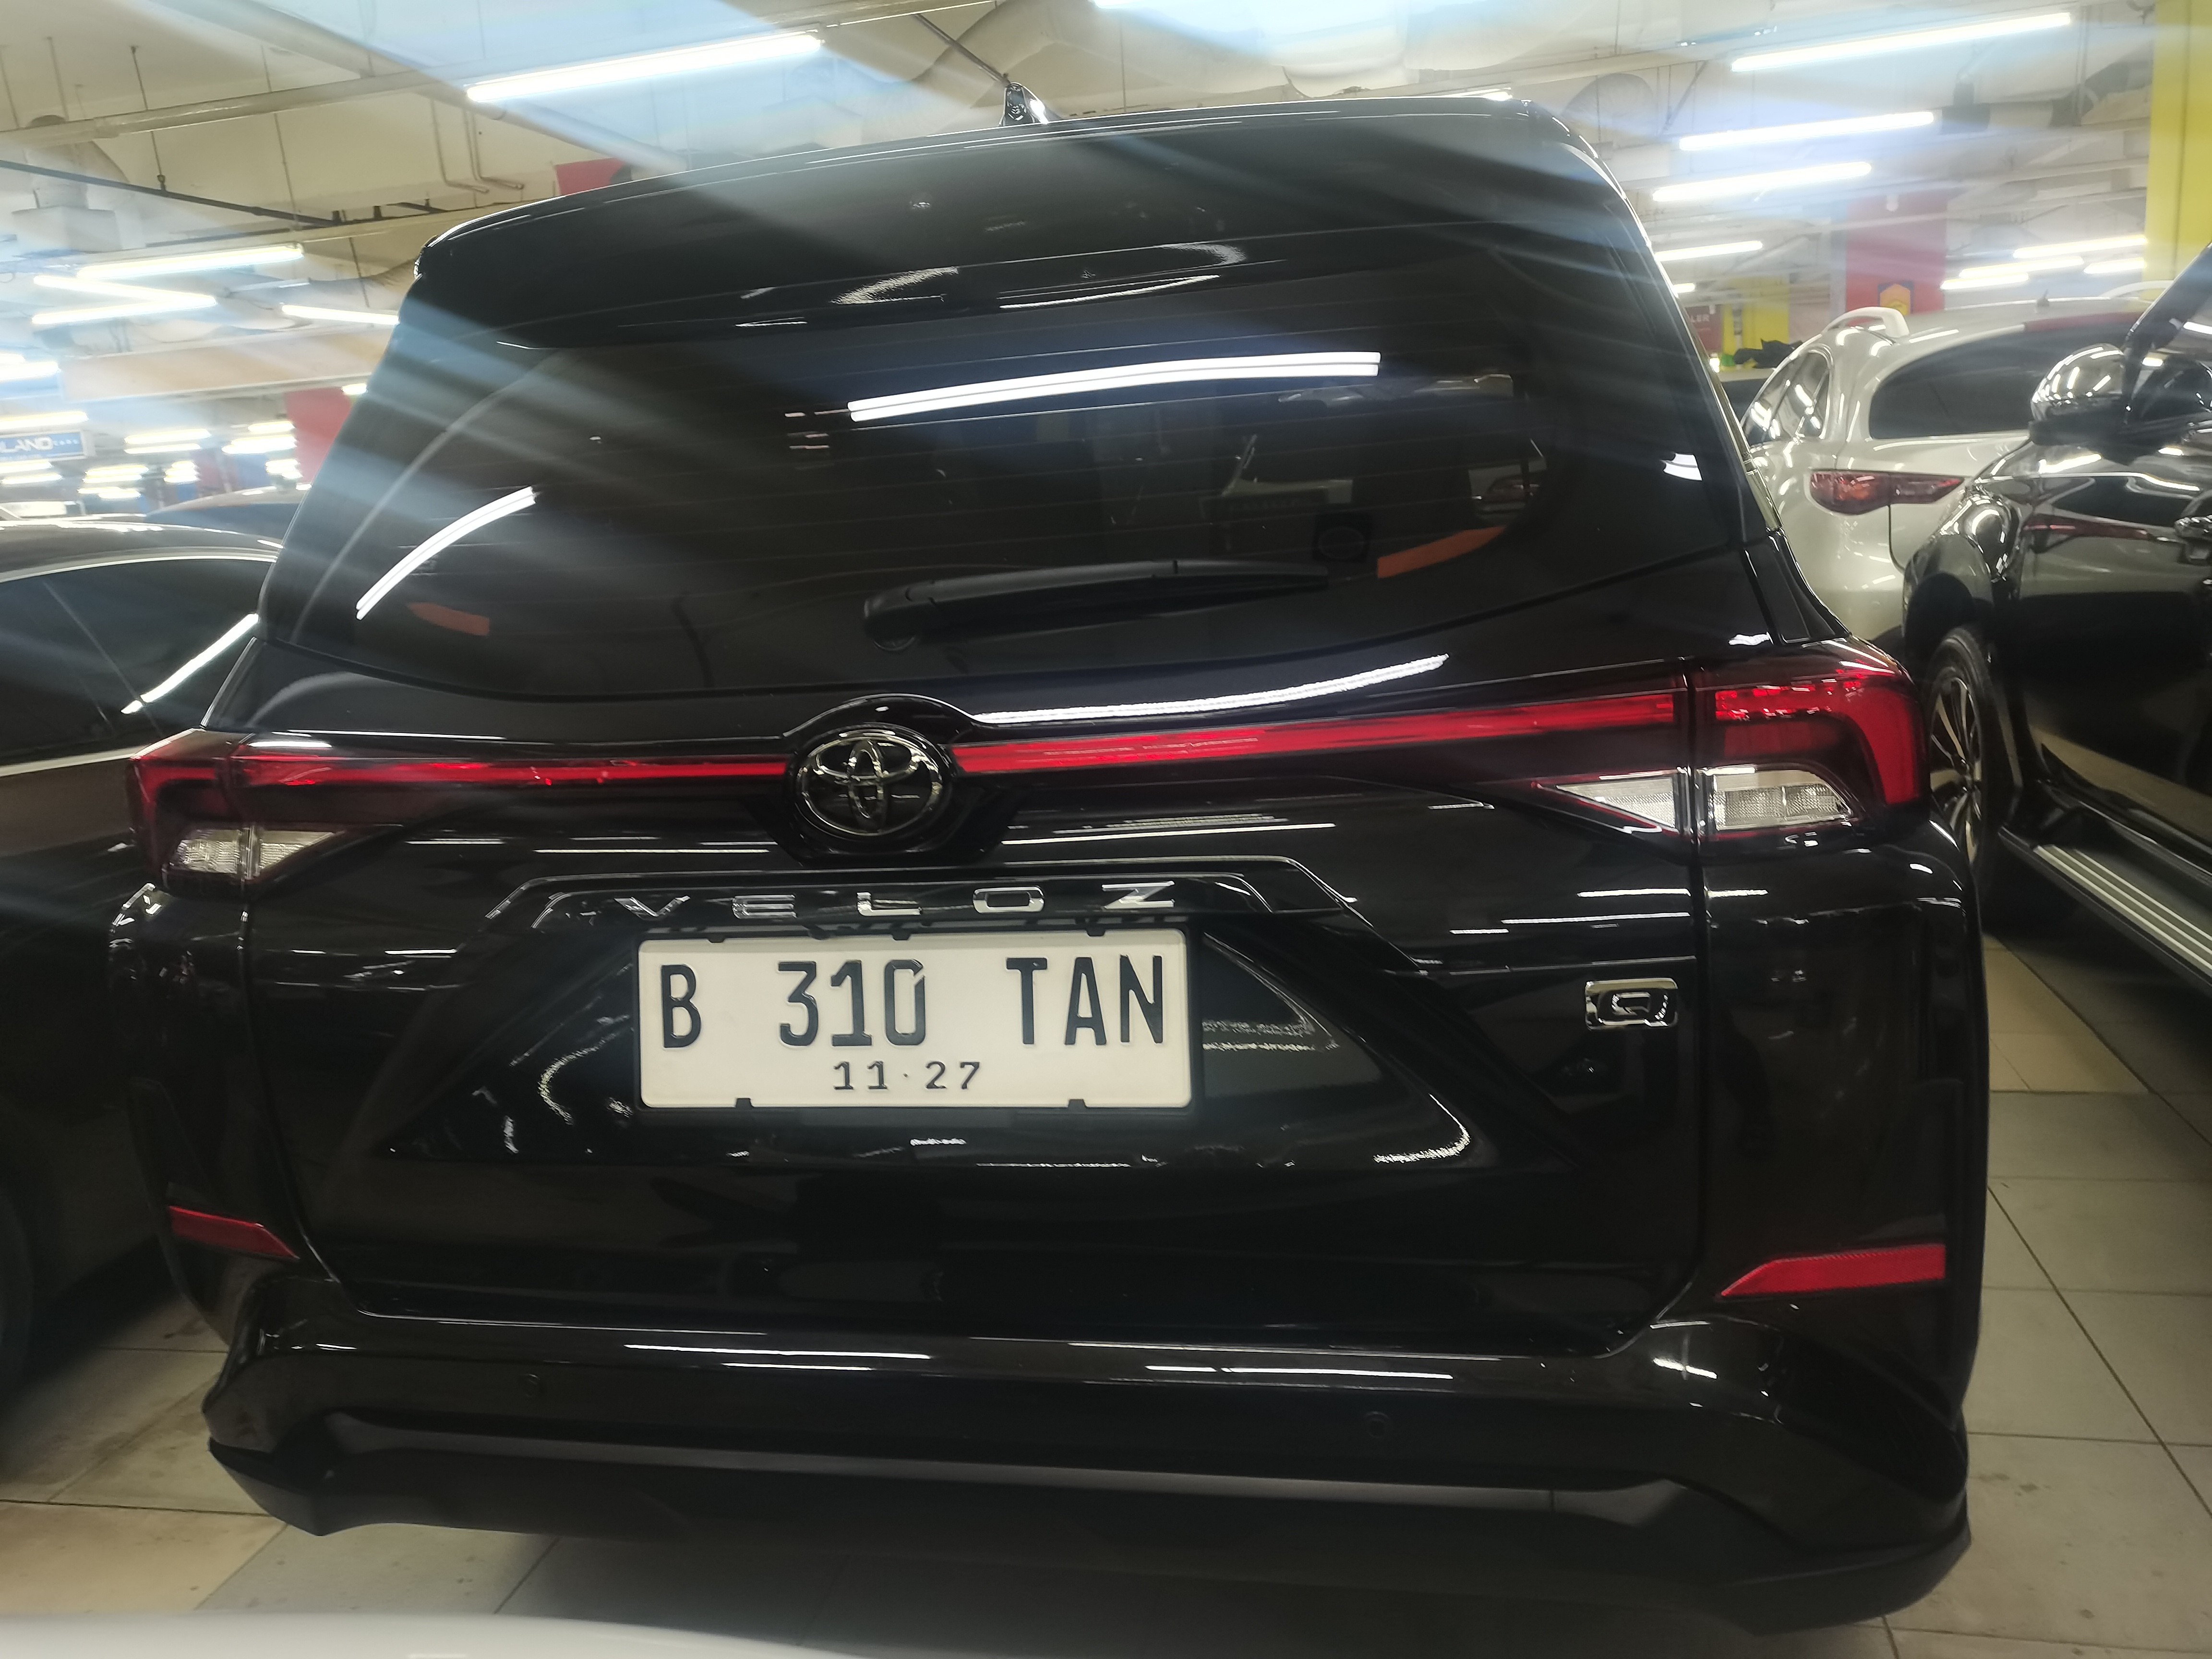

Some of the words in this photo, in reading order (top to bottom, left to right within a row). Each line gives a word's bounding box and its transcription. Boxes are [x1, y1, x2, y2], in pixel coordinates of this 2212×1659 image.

[614, 881, 1175, 921] VELOZ
[661, 964, 701, 1048] B
[778, 960, 926, 1046] 310
[1006, 955, 1163, 1046] TAN
